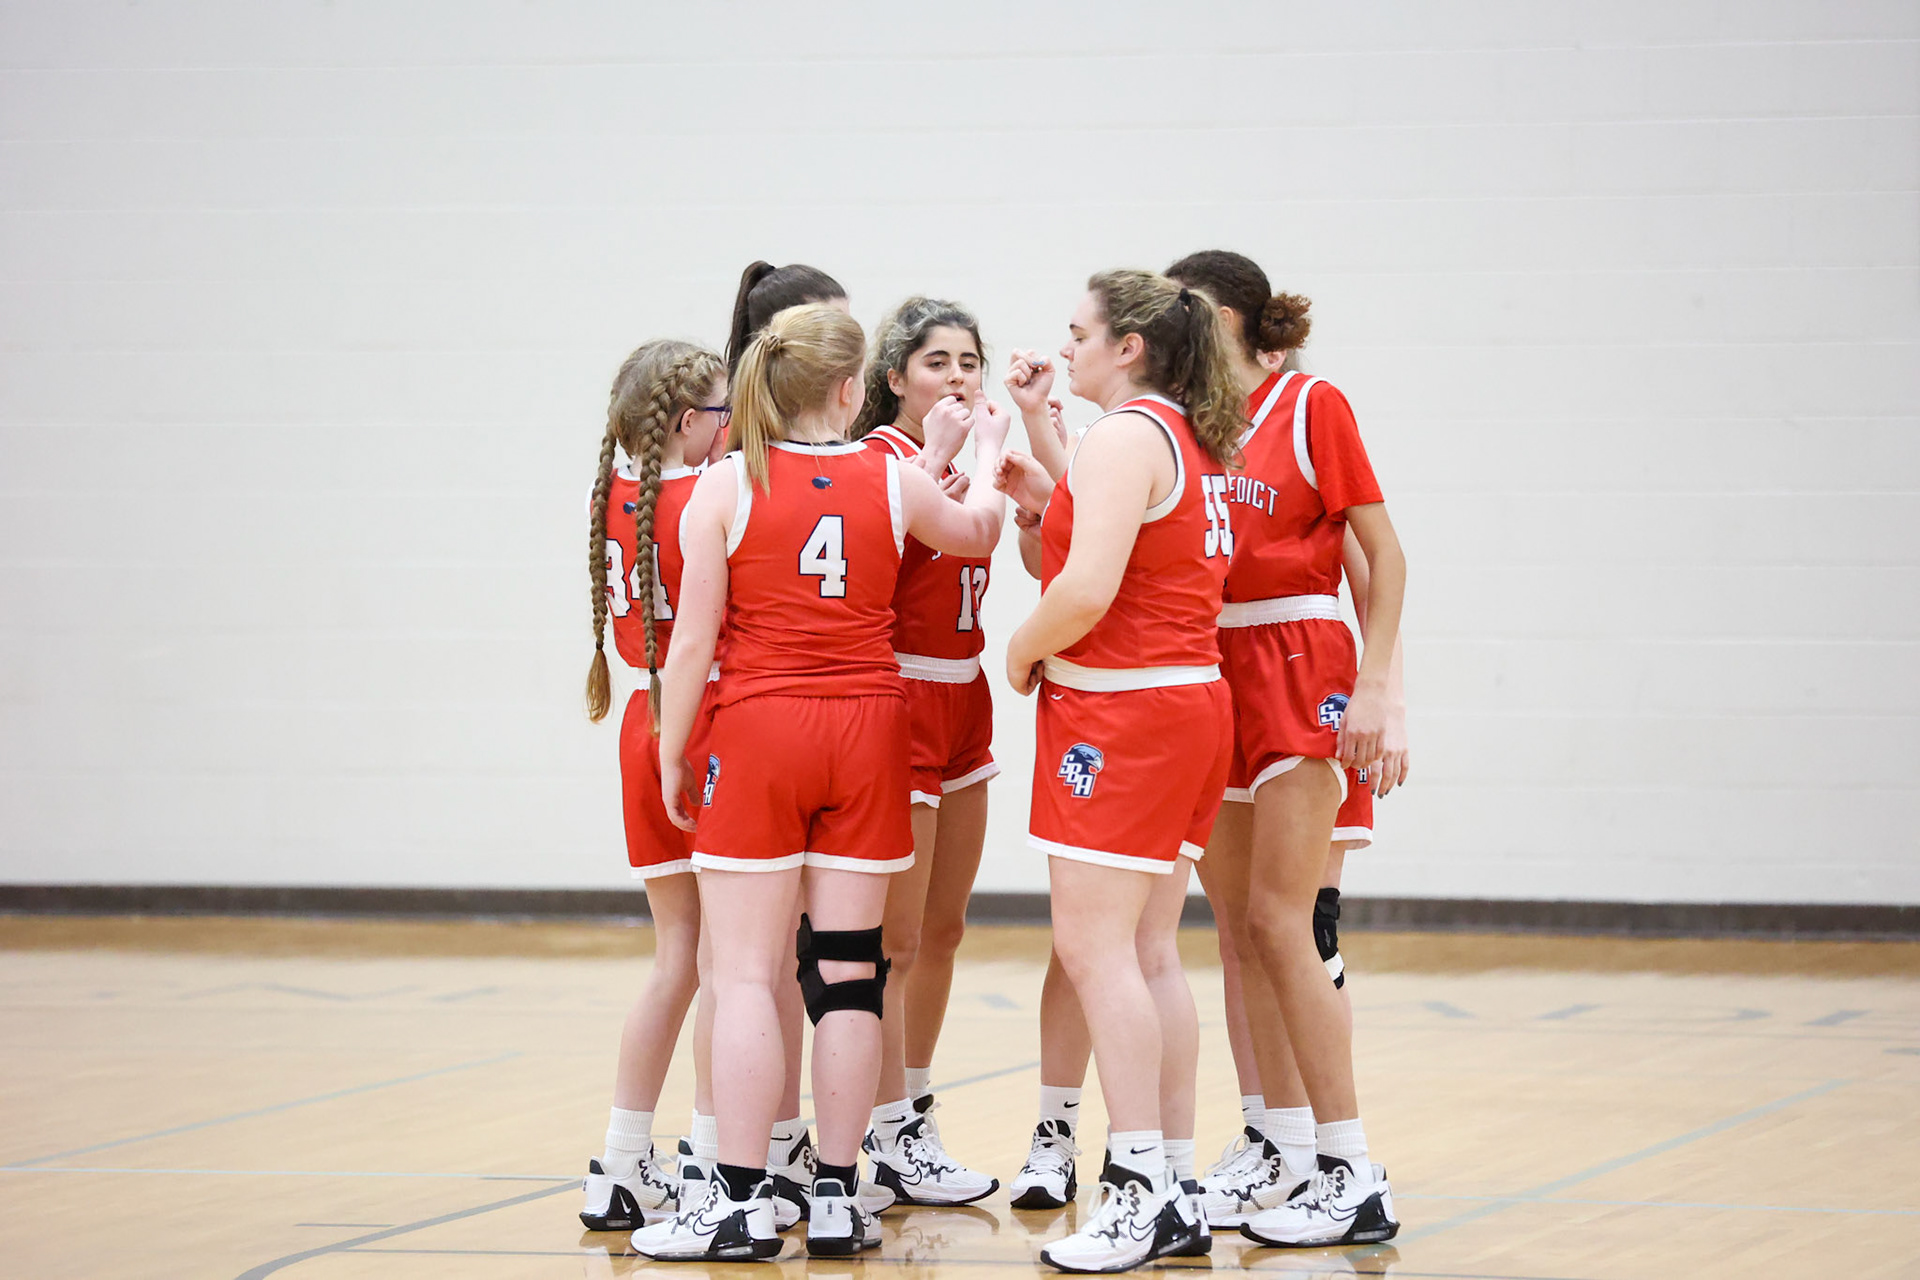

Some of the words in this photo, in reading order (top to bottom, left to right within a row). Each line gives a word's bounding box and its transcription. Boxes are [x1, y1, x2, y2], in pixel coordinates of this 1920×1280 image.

[799, 514, 848, 598] 4
[1200, 474, 1235, 559] 55
[1060, 753, 1095, 796] SBA
